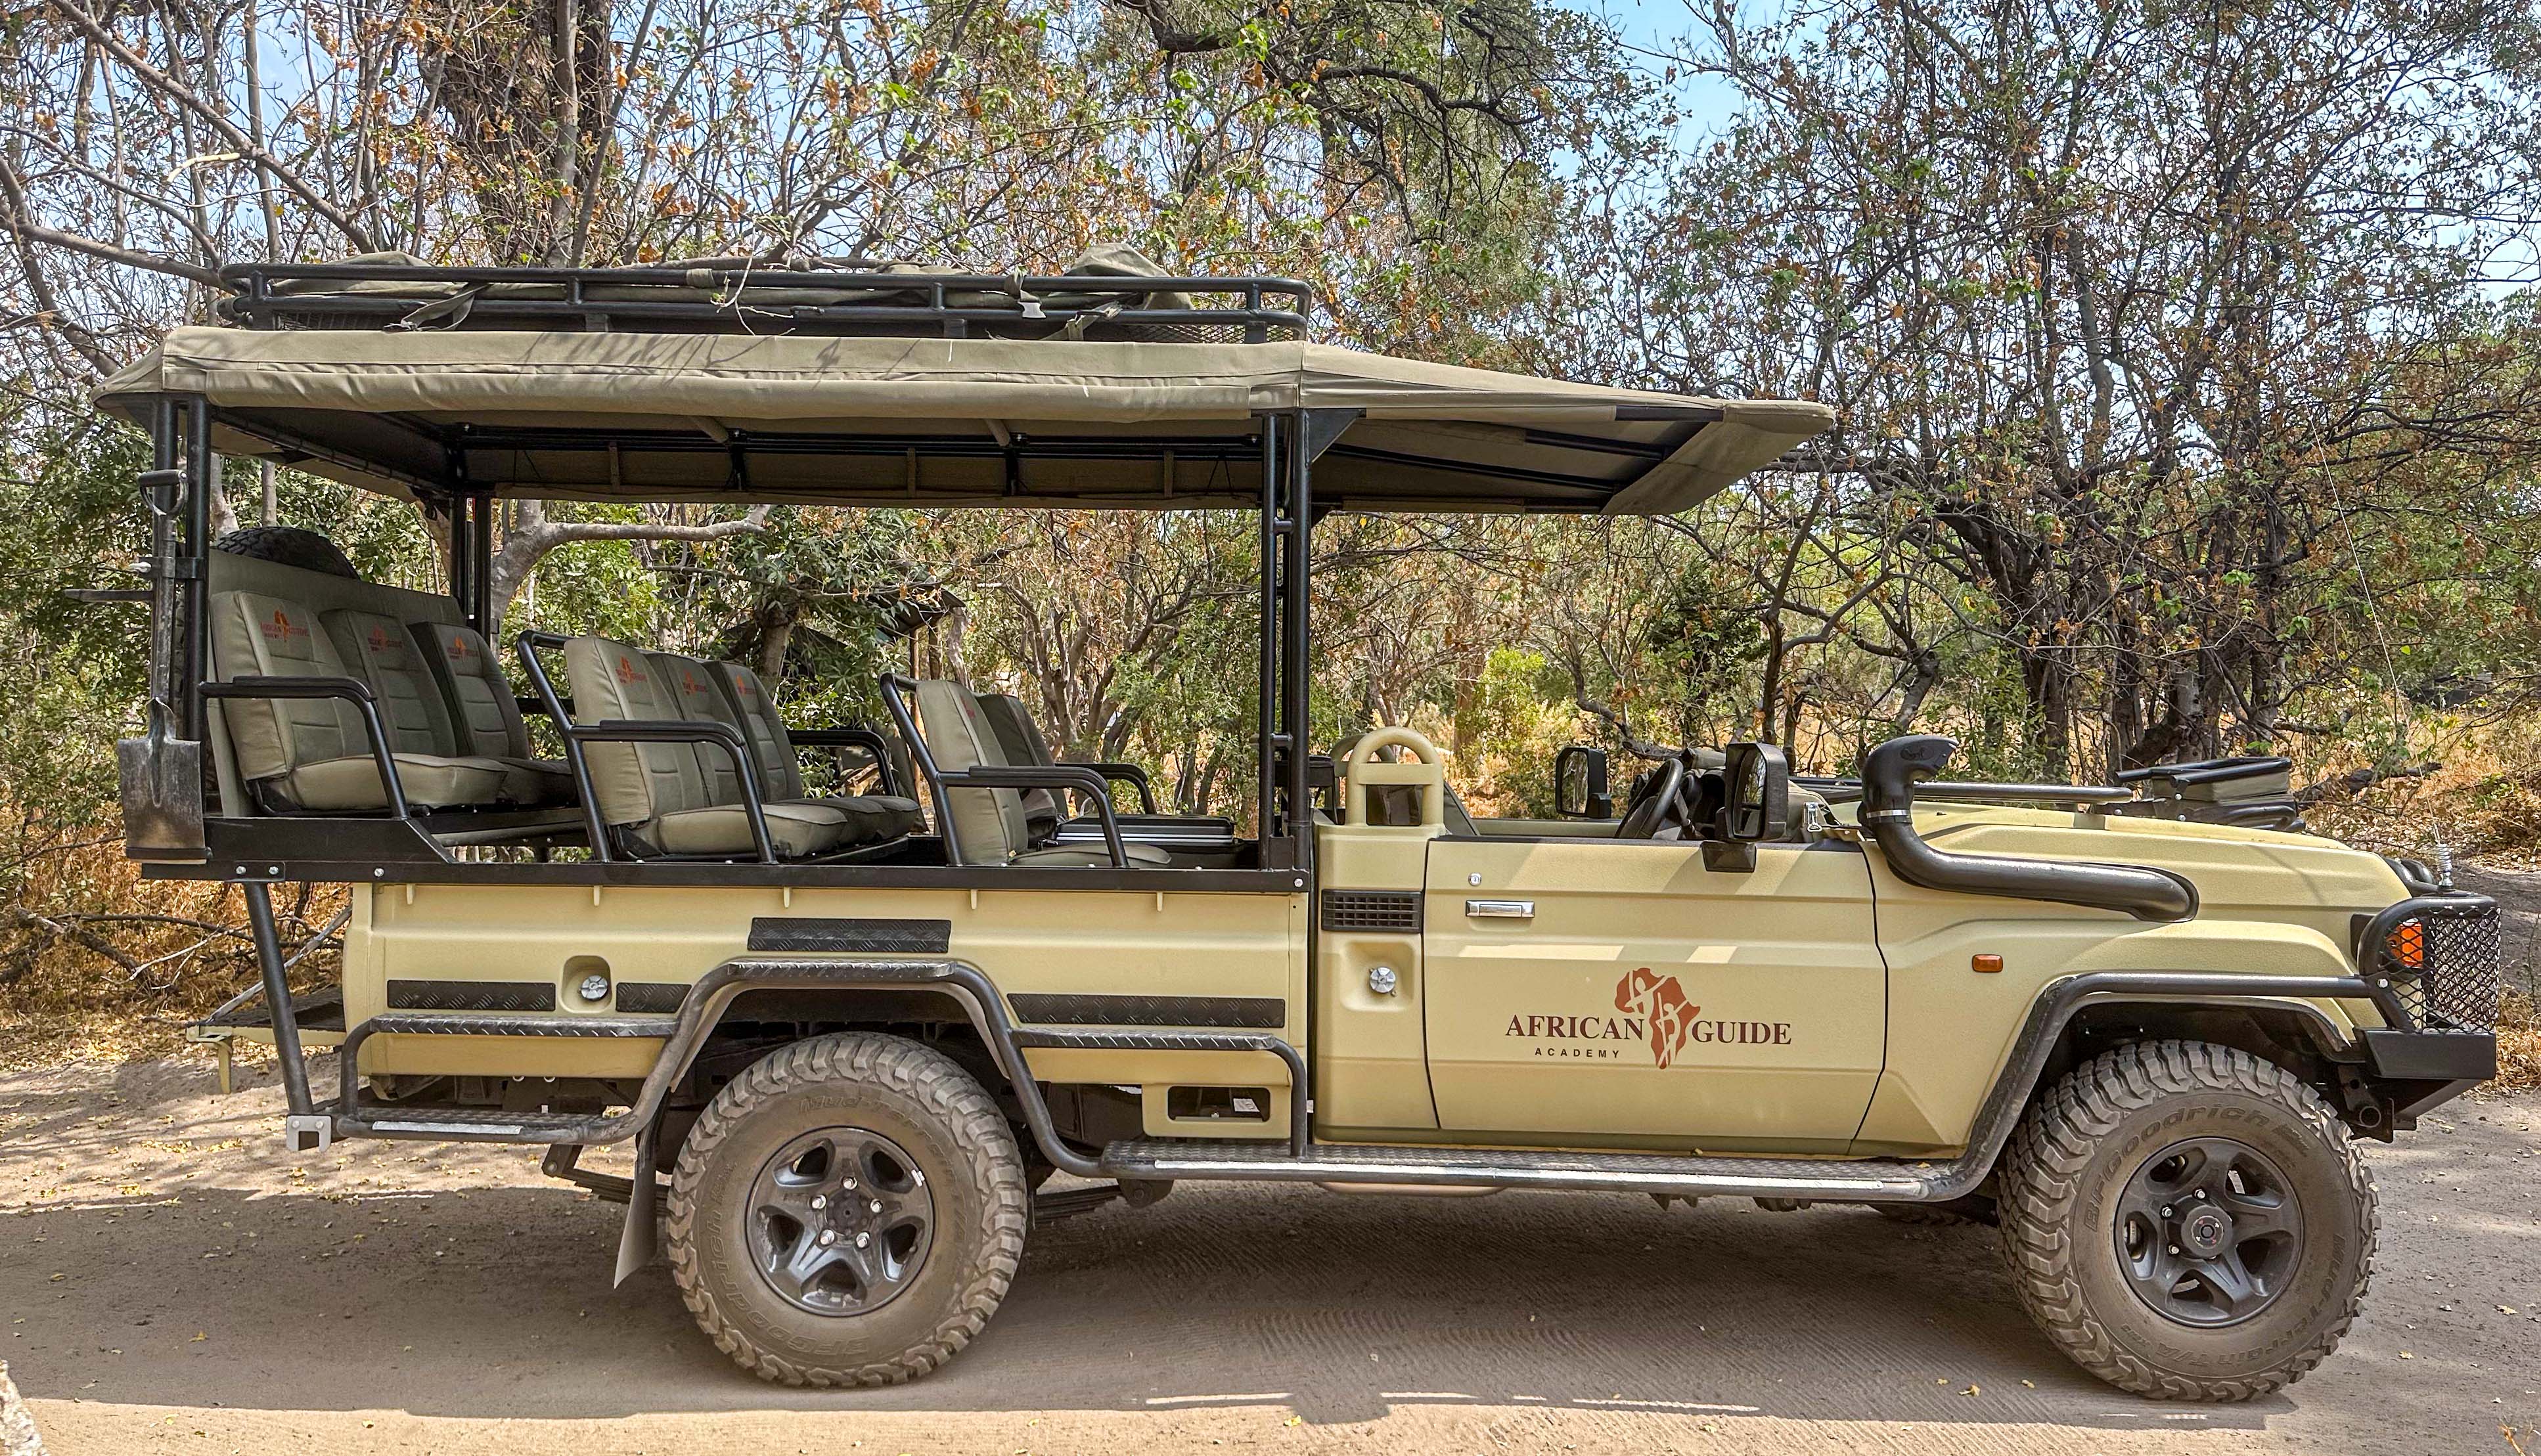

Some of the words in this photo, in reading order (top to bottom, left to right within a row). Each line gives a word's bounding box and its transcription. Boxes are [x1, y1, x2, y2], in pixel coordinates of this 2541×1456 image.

[1505, 1014, 1643, 1040] AFRICAN
[1692, 1020, 1792, 1046] GUIDE
[1535, 1048, 1619, 1059] ACADEMY
[2084, 1103, 2270, 1232] BFGoodrich
[706, 1210, 870, 1355] BFGoodrich
